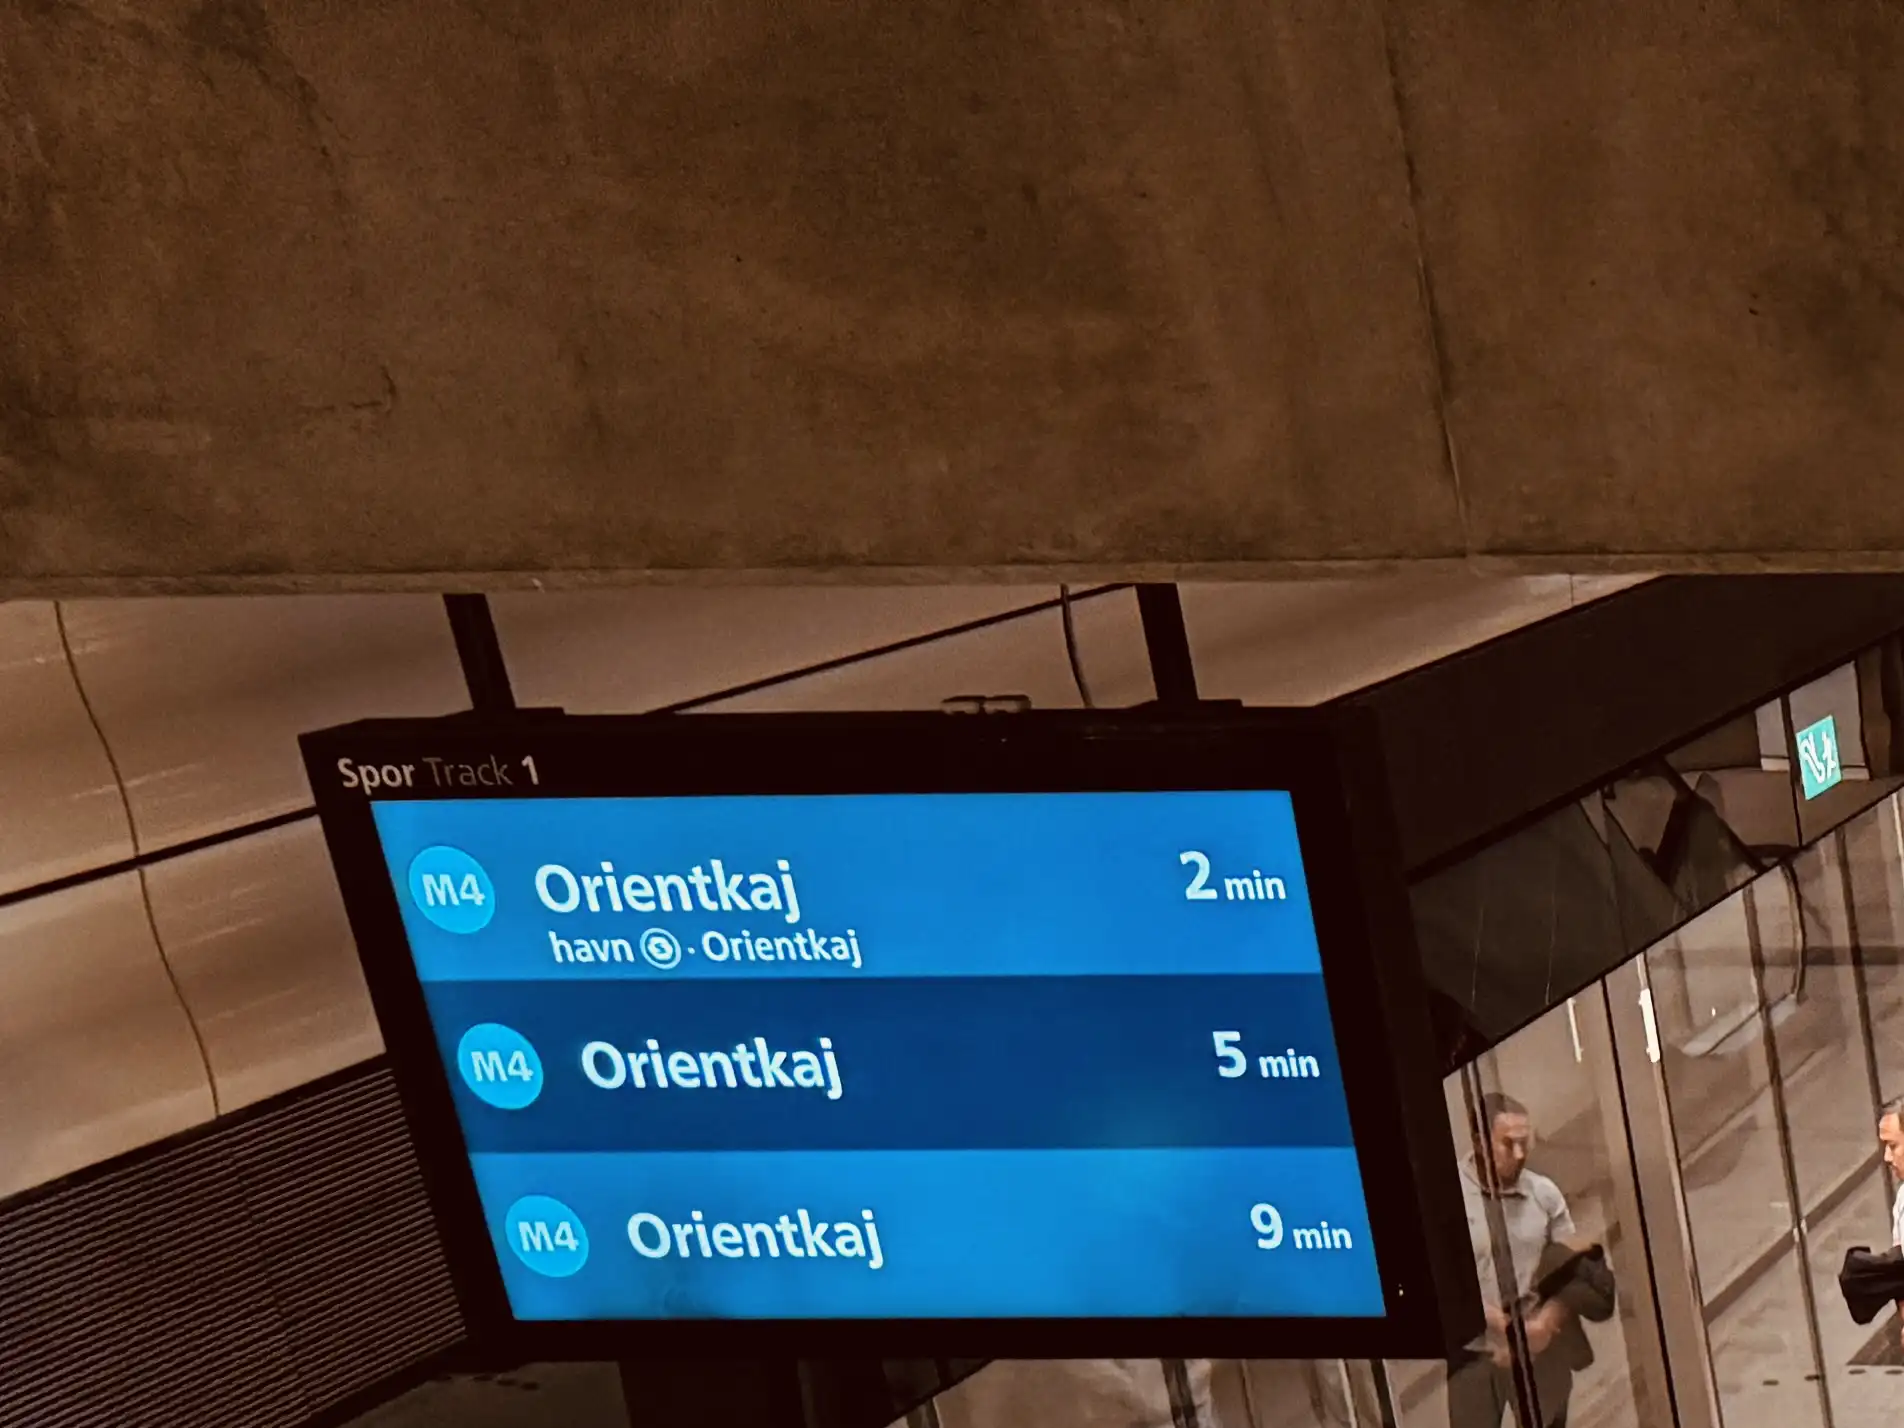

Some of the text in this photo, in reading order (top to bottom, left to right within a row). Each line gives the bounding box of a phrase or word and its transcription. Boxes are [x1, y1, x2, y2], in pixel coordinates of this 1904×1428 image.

[337, 754, 541, 796] Spor Track 1
[422, 850, 1287, 925] M4 Orientkaj 2 min
[548, 929, 636, 963] havn
[701, 927, 863, 969] Orientkaj
[469, 1029, 1321, 1101] M4 Orientkaj 5 min
[516, 1201, 1354, 1271] M4 Orientkaj 9 min
